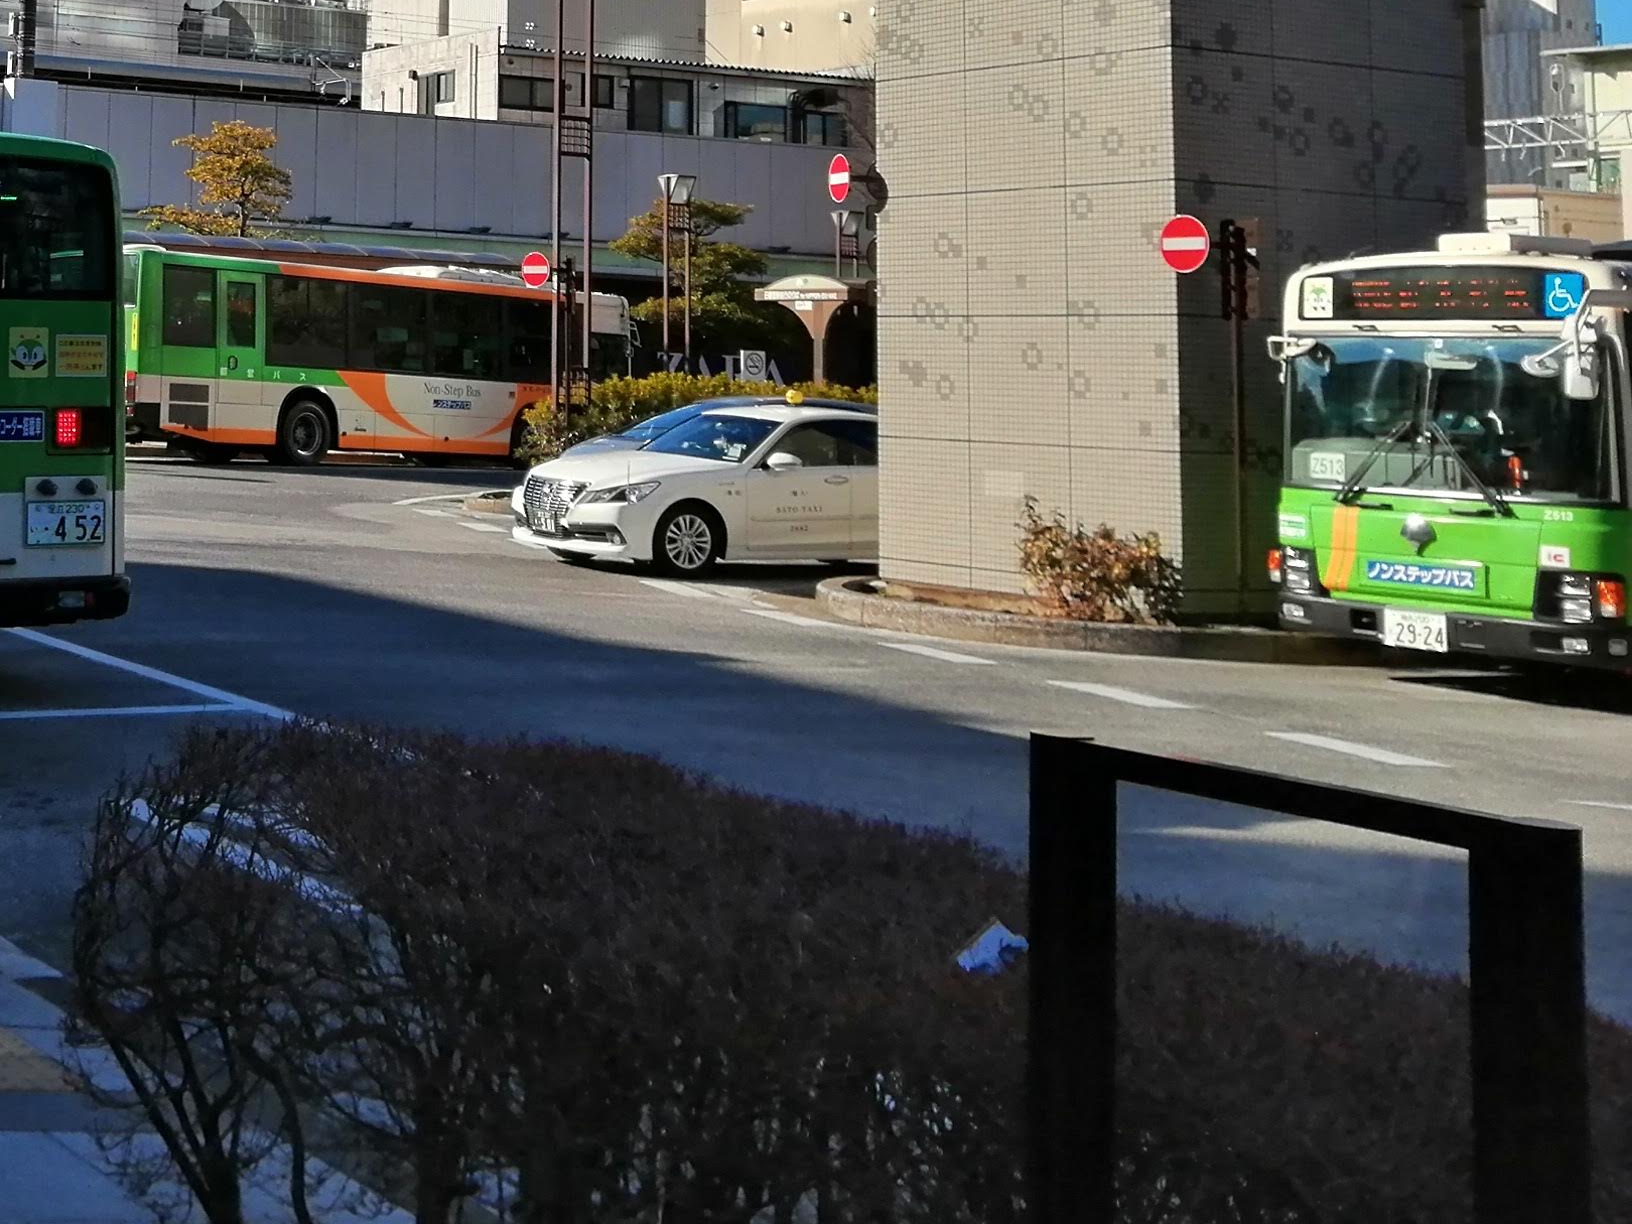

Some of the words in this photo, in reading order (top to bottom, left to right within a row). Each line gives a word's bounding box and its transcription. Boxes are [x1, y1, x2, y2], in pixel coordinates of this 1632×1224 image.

[1311, 452, 1345, 475] Z513
[1543, 509, 1574, 522] Z513
[1368, 562, 1475, 588] ノンステップバス
